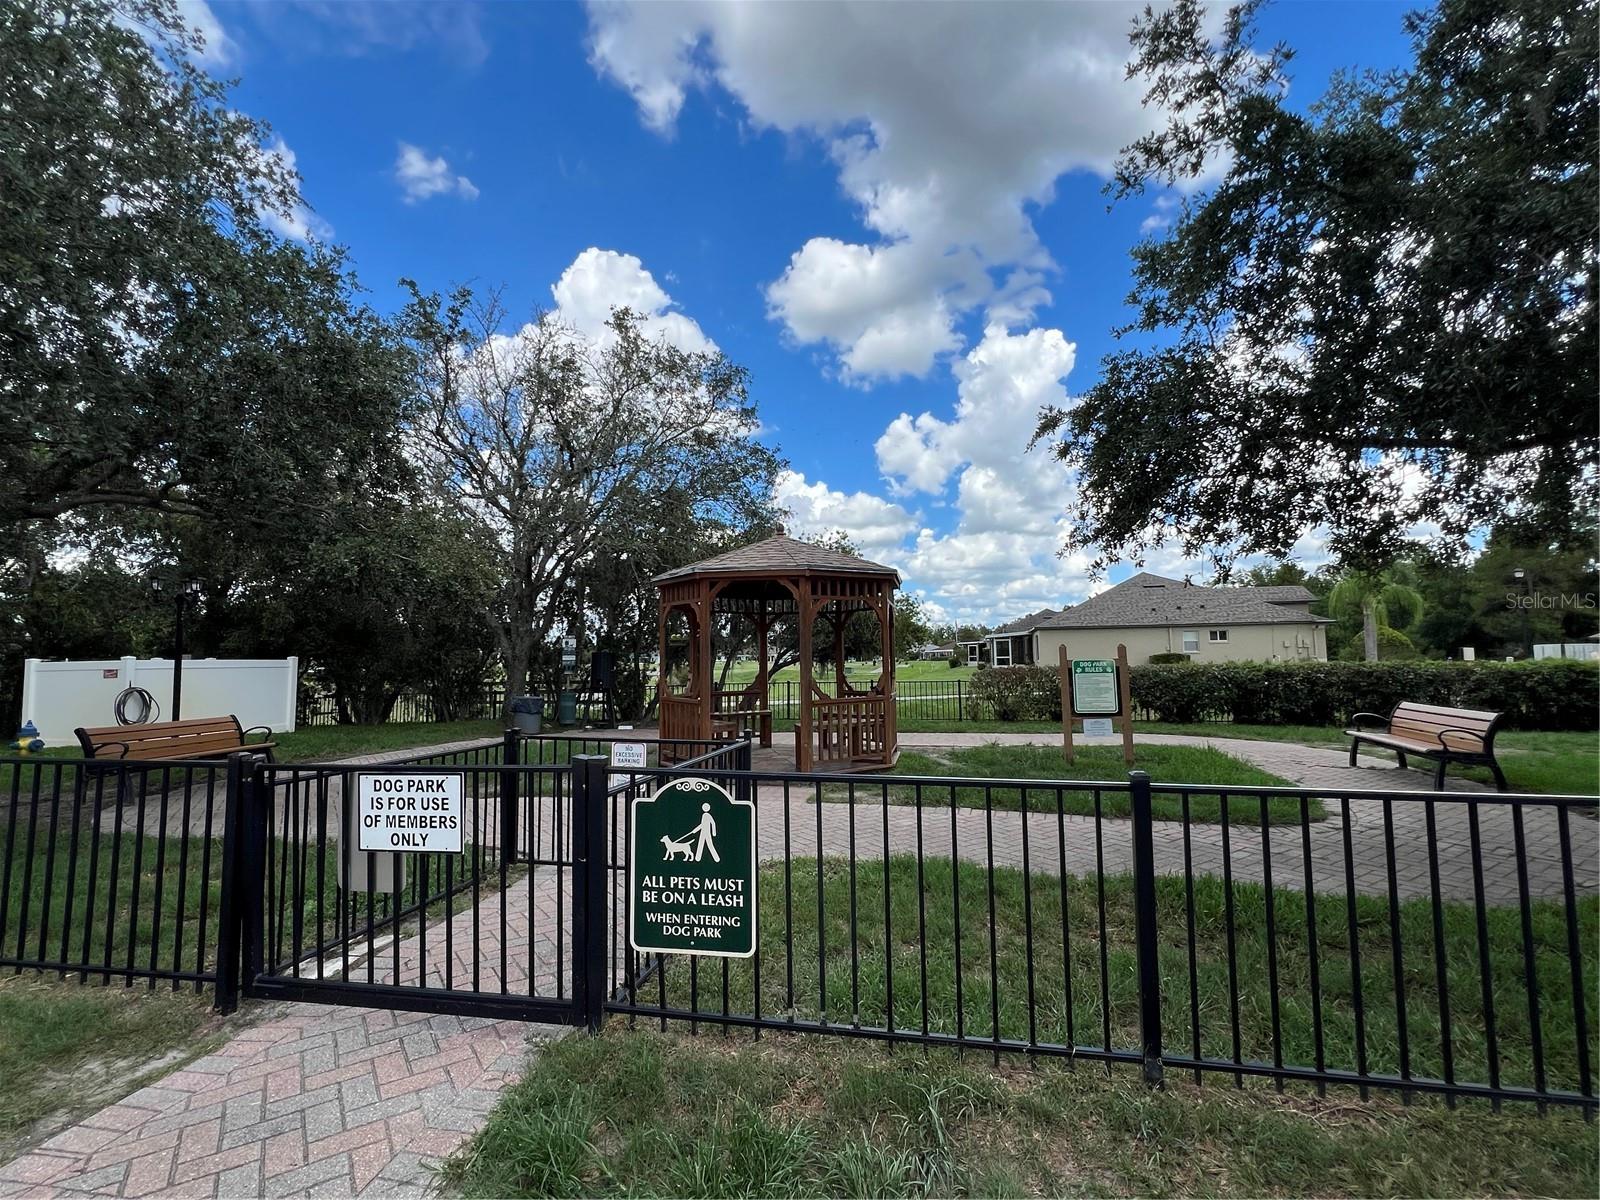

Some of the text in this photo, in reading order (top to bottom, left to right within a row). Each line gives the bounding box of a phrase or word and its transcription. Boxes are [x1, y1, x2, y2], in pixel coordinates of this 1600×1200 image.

[373, 779, 446, 792] DOG PARK
[371, 797, 449, 811] IS FOR USE
[364, 814, 457, 829] OF MEMBERS
[390, 833, 429, 847] ONLY
[642, 875, 744, 892] ALL PETS MUST
[642, 890, 744, 908] BE ON A LEASH
[646, 912, 741, 927] WHEN ENTERING
[663, 925, 722, 938] DOG PARK
